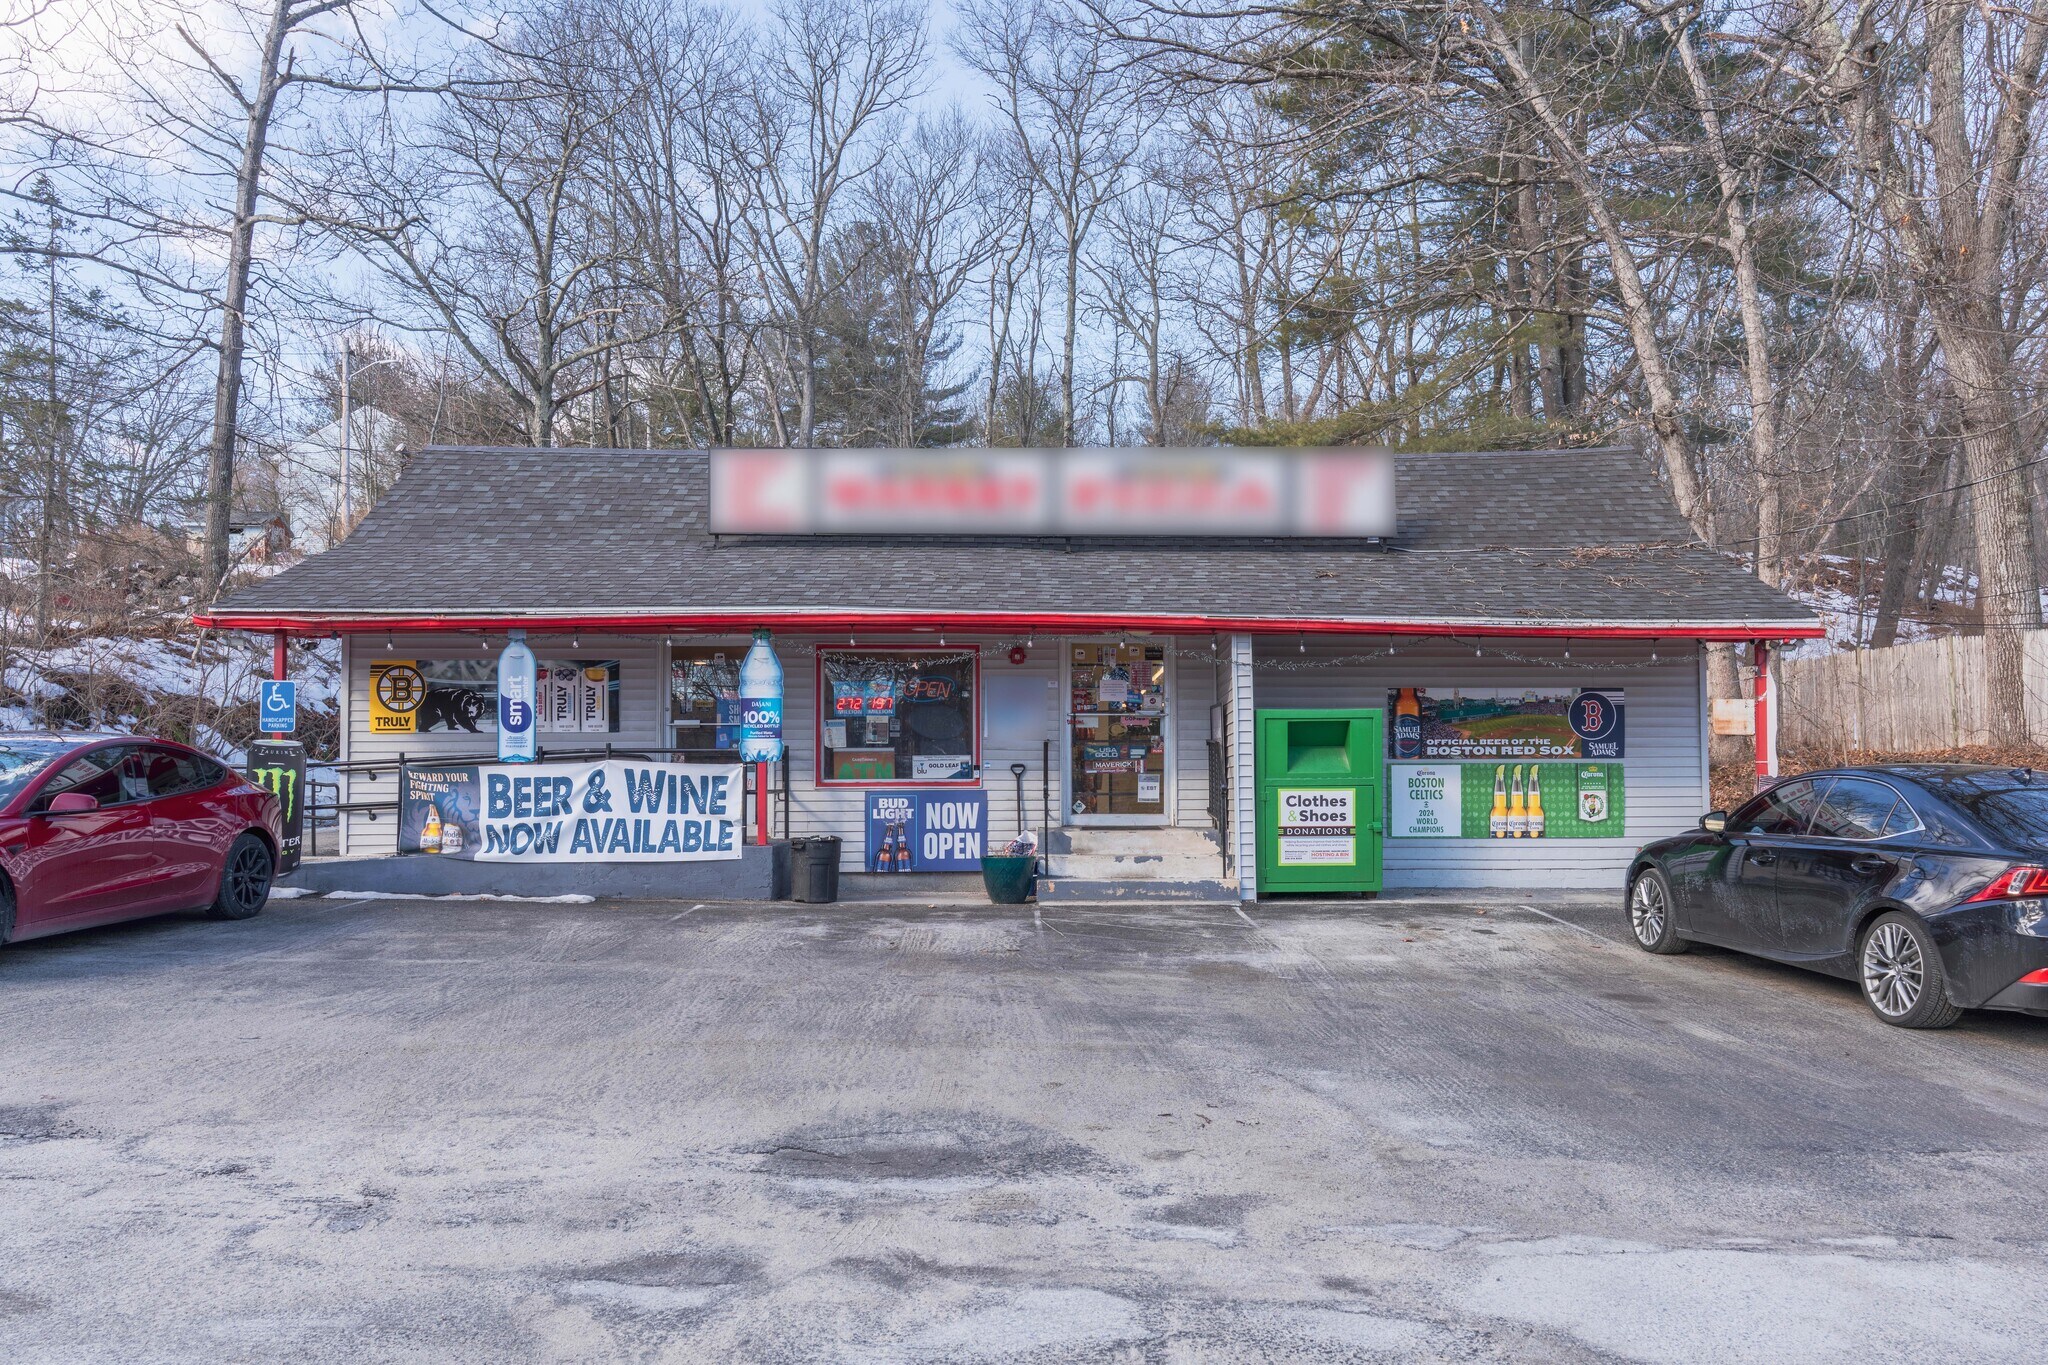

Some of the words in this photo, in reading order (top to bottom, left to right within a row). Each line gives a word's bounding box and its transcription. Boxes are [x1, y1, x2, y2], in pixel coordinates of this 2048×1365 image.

[903, 680, 952, 698] OPEN
[508, 675, 522, 726] smart
[557, 686, 567, 721] TRULY
[586, 686, 596, 721] TRULY
[836, 698, 863, 710] 272
[872, 697, 893, 710] 197
[375, 716, 411, 727] TRULY
[743, 711, 780, 723] 100%
[1581, 700, 1603, 732] B
[1393, 725, 1421, 733] SAMUEL
[1396, 732, 1420, 740] ADAMS
[1426, 746, 1499, 756] BOSTON
[1501, 746, 1536, 756] RED
[1539, 746, 1575, 756] SOX
[1588, 741, 1619, 750] SAMUEL
[1591, 749, 1616, 757] ADAMS
[445, 772, 469, 782] YOUR
[838, 763, 893, 779] ATM
[1581, 771, 1604, 779] Corona
[1408, 777, 1445, 788] BOSTON
[487, 773, 574, 819] BEER
[583, 768, 613, 814] &
[624, 768, 730, 815] WINE
[1410, 789, 1443, 800] CELTICS
[879, 798, 909, 809] BUD
[1286, 795, 1347, 807] Clothes
[872, 808, 914, 819] LIGHT
[926, 802, 980, 830] NOW
[1288, 809, 1297, 822] &
[1299, 809, 1347, 822] Shoes
[484, 820, 562, 856] NOW
[569, 817, 735, 854] AVAILABLE
[923, 832, 981, 860] OPEN
